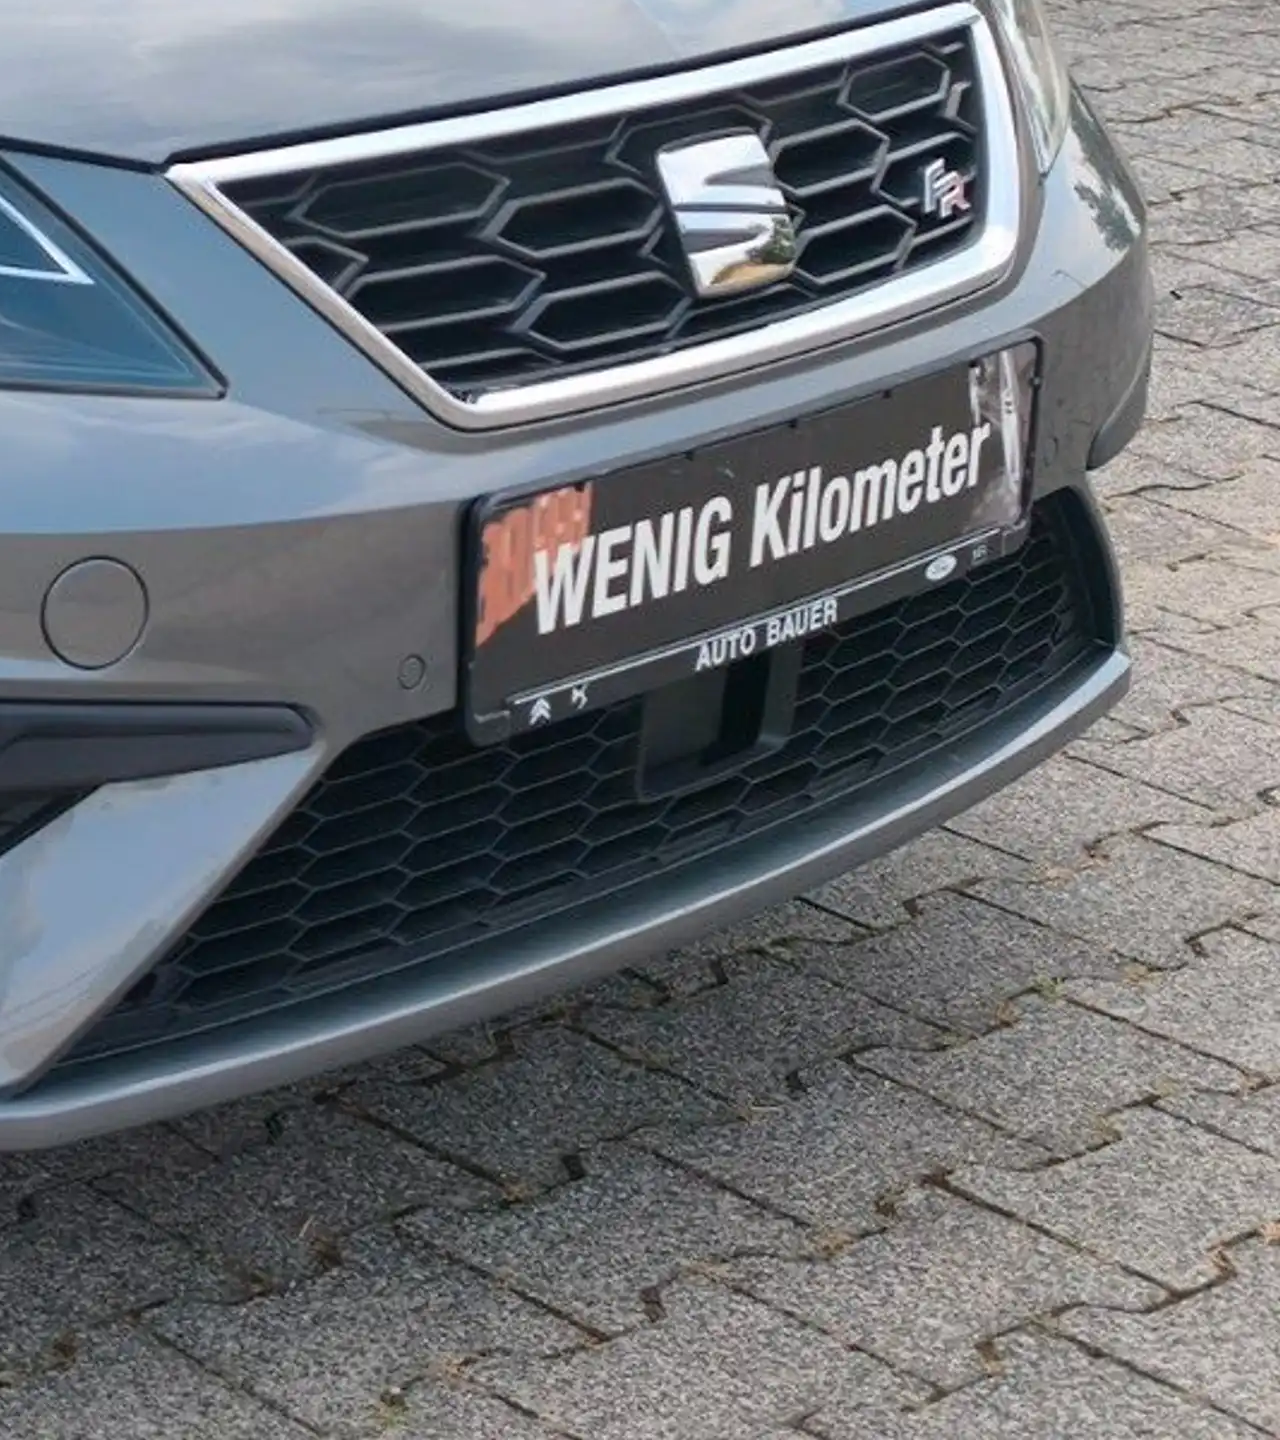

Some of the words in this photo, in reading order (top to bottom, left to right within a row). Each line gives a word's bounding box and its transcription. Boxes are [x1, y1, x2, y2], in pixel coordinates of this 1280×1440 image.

[534, 496, 732, 635] WENIG
[749, 421, 991, 567] Kilometer
[695, 626, 757, 671] AUTO
[766, 597, 837, 646] BAUER
